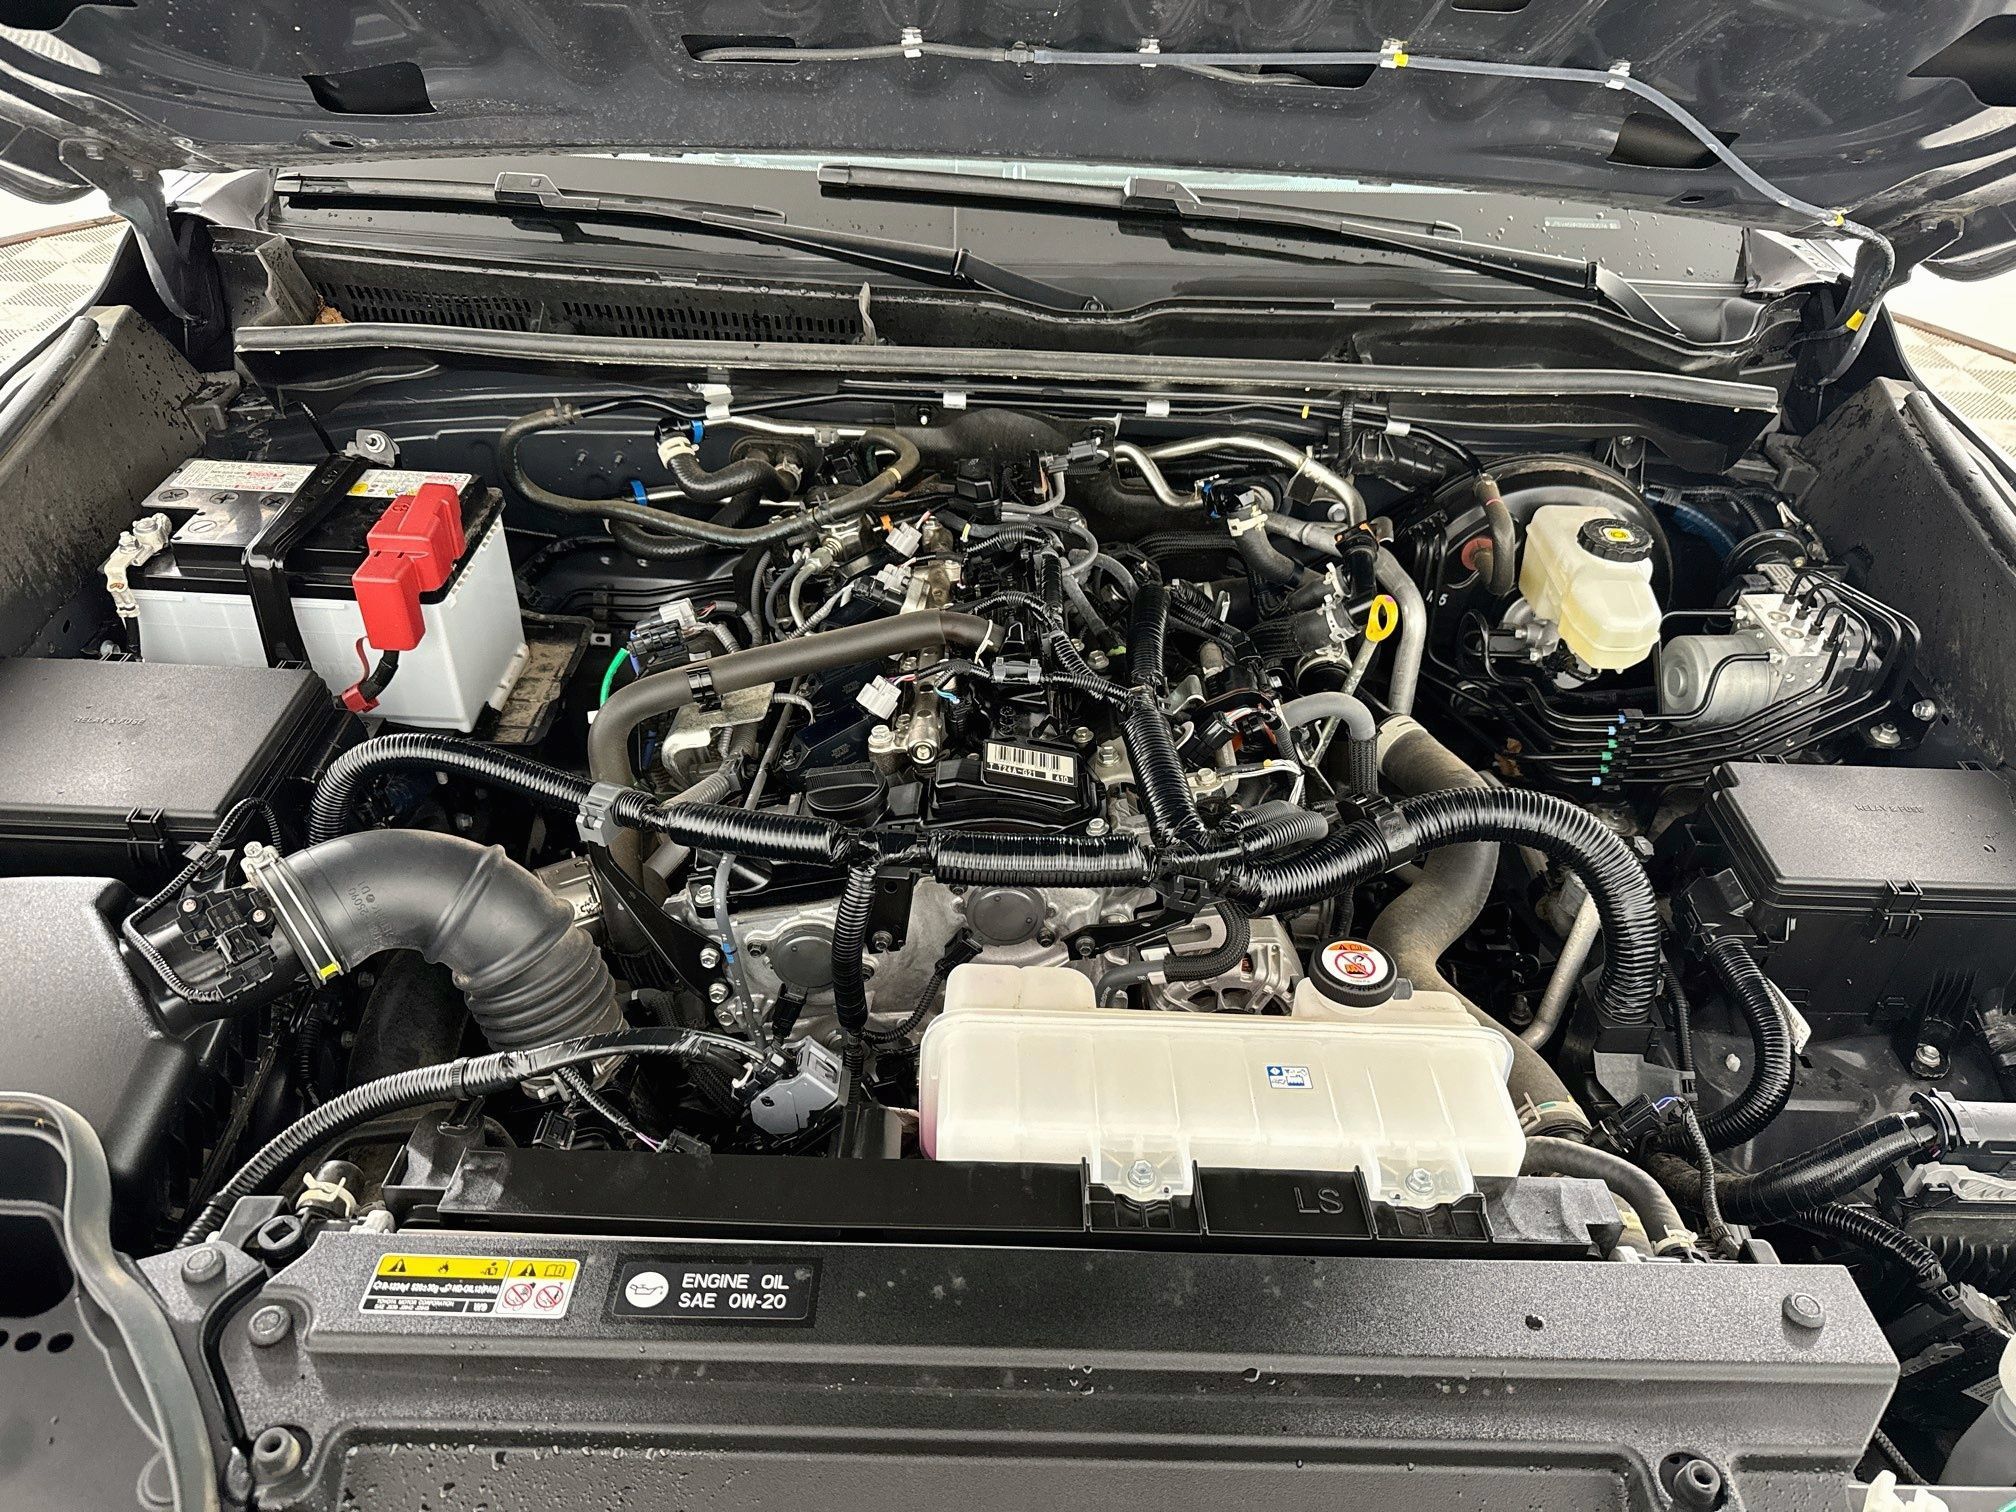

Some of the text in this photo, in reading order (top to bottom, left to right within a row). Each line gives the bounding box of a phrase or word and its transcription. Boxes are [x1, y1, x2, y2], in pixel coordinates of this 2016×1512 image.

[1293, 1186, 1344, 1214] LS
[681, 1273, 790, 1290] ENGINE OIL
[678, 1292, 787, 1309] SAE 0W-20
